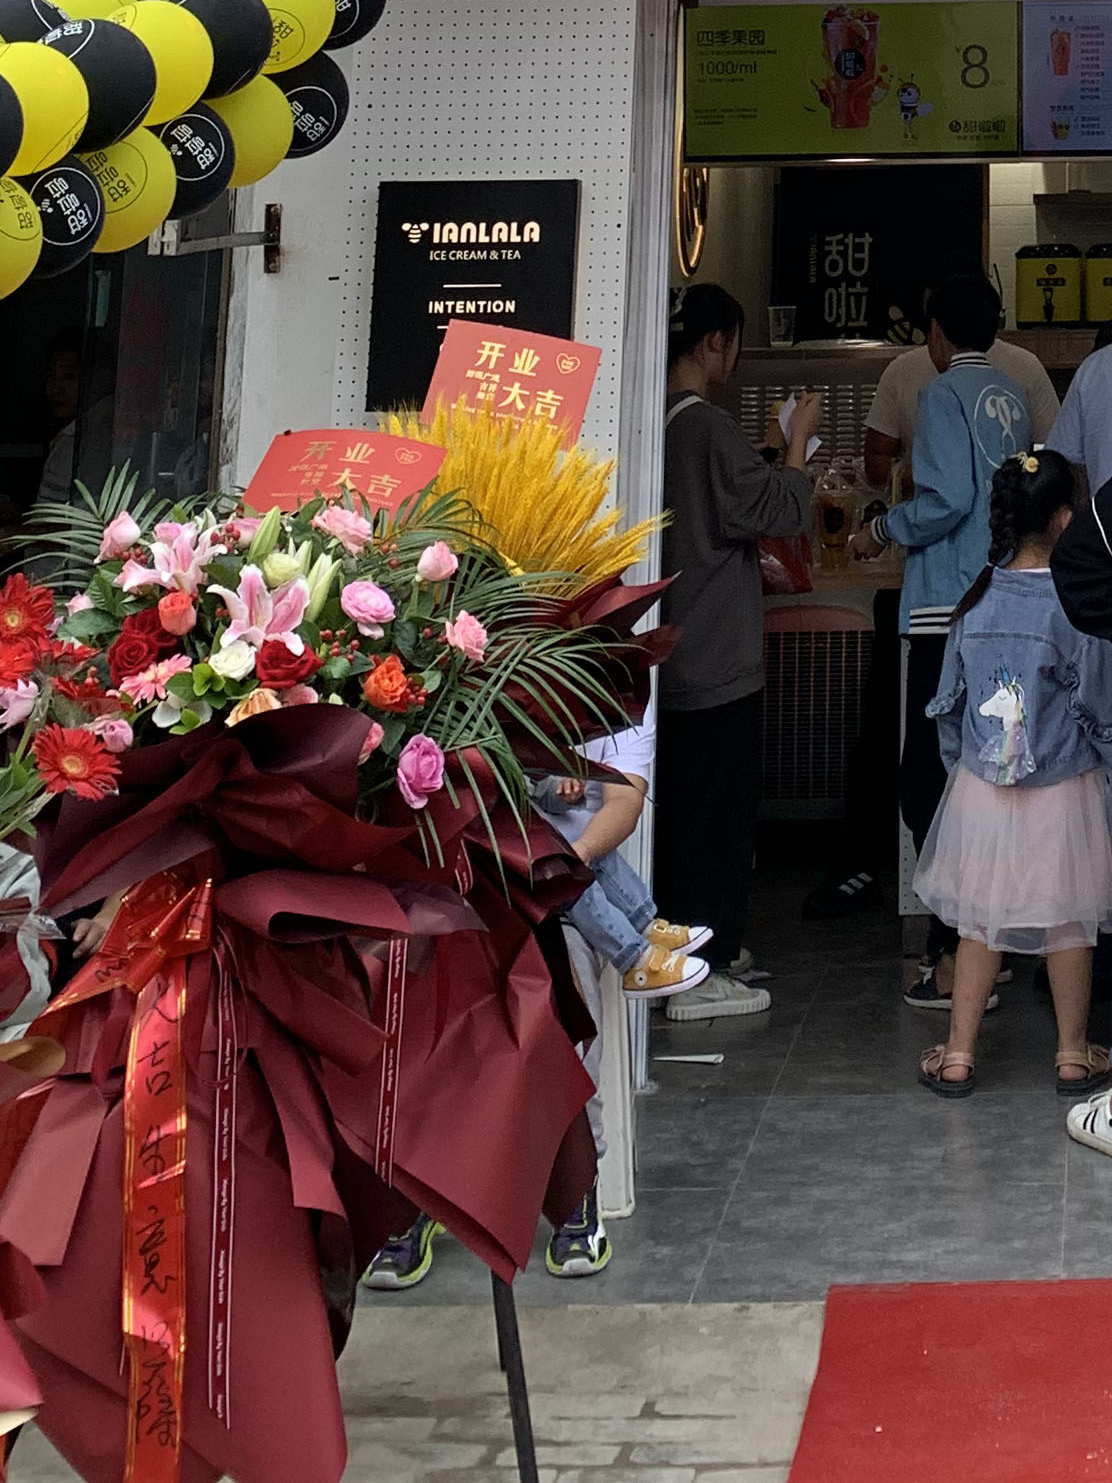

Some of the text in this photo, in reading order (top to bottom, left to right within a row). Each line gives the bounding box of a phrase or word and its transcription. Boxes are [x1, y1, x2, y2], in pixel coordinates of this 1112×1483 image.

[697, 29, 765, 46] 四季果园
[429, 249, 521, 262] ICE CREAM & TEA
[824, 231, 873, 338] 甜啦
[428, 300, 516, 315] INTENTION
[475, 340, 541, 377] 开业
[498, 381, 564, 420] 大吉
[300, 440, 376, 465] 开业
[327, 467, 402, 498] 大吉
